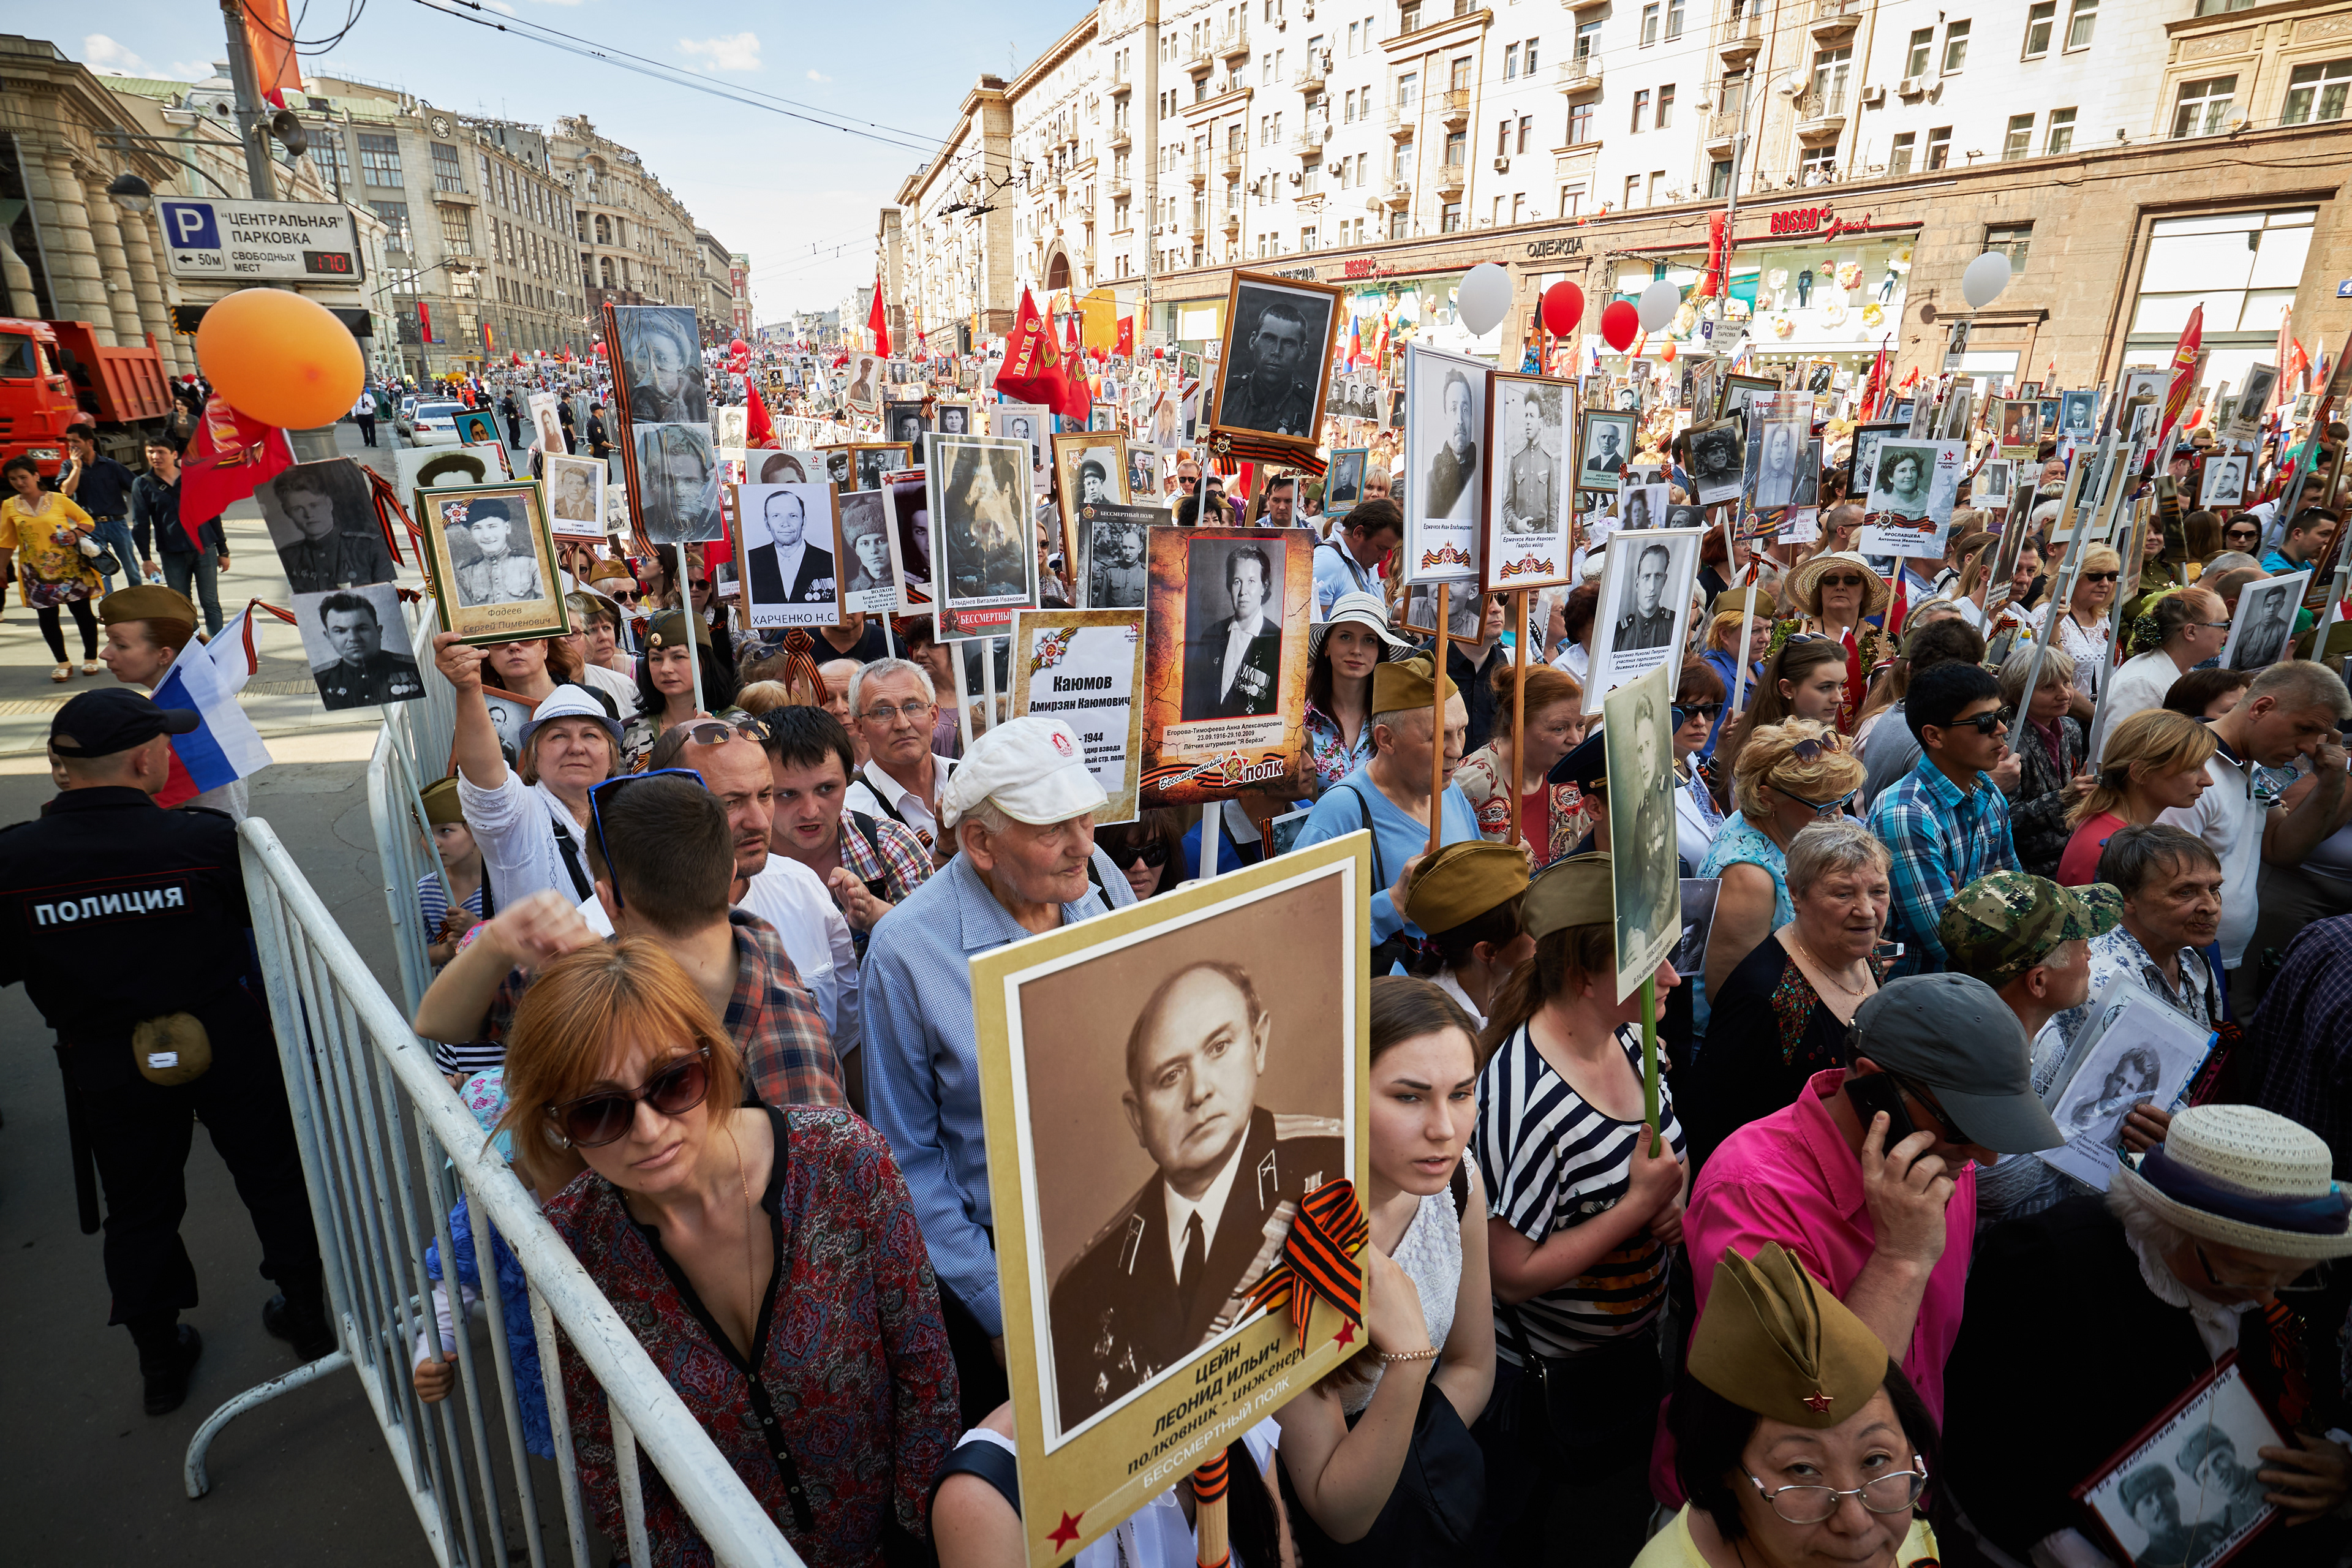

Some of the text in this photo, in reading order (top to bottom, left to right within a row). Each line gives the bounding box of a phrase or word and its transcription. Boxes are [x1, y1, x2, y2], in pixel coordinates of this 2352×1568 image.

[175, 208, 204, 243] P
[1770, 207, 1871, 245] BOSCO fresh
[232, 230, 311, 245] ПАРКОВКА
[1527, 236, 1584, 258] ОДЕЖДА
[232, 251, 296, 262] СВОБОДНЫХ
[317, 254, 347, 272] 170
[234, 263, 261, 273] МЕСТ
[1344, 260, 1370, 276] BOSCO
[951, 598, 975, 606] Злыднев
[977, 596, 998, 605] Виталий
[488, 607, 522, 617] Фадеев
[752, 612, 838, 625] ХАРЧЕНКО Н.С.
[463, 617, 551, 634] Сергей Пименович
[1053, 676, 1112, 692] Каюмов
[1030, 696, 1131, 713] Амирзян Каюмович
[1167, 726, 1225, 736] Егорова-Тимофеева
[1242, 721, 1283, 729] Александровна
[1197, 730, 1255, 741] 23.09.1916-29.10.2009
[1083, 732, 1104, 743] 1944
[1205, 739, 1237, 748] штурмовик
[1098, 755, 1110, 763] стр.
[1158, 753, 1284, 791] Бессмертный ПОЛК
[34, 886, 185, 925] ПОЛИЦИЯ
[2082, 1135, 2114, 1157] Яков Гаврилович
[2076, 1147, 2098, 1163] Тернополем
[1195, 1341, 1241, 1385] ЦЕЙН
[1152, 1338, 1281, 1438] ЛЕОНИД ИЛЬИЧ
[1127, 1404, 1218, 1476] полковник
[1232, 1348, 1302, 1403] инженер
[1143, 1375, 1290, 1490] БЕССМЕРТНЫЙ ПОЛК
